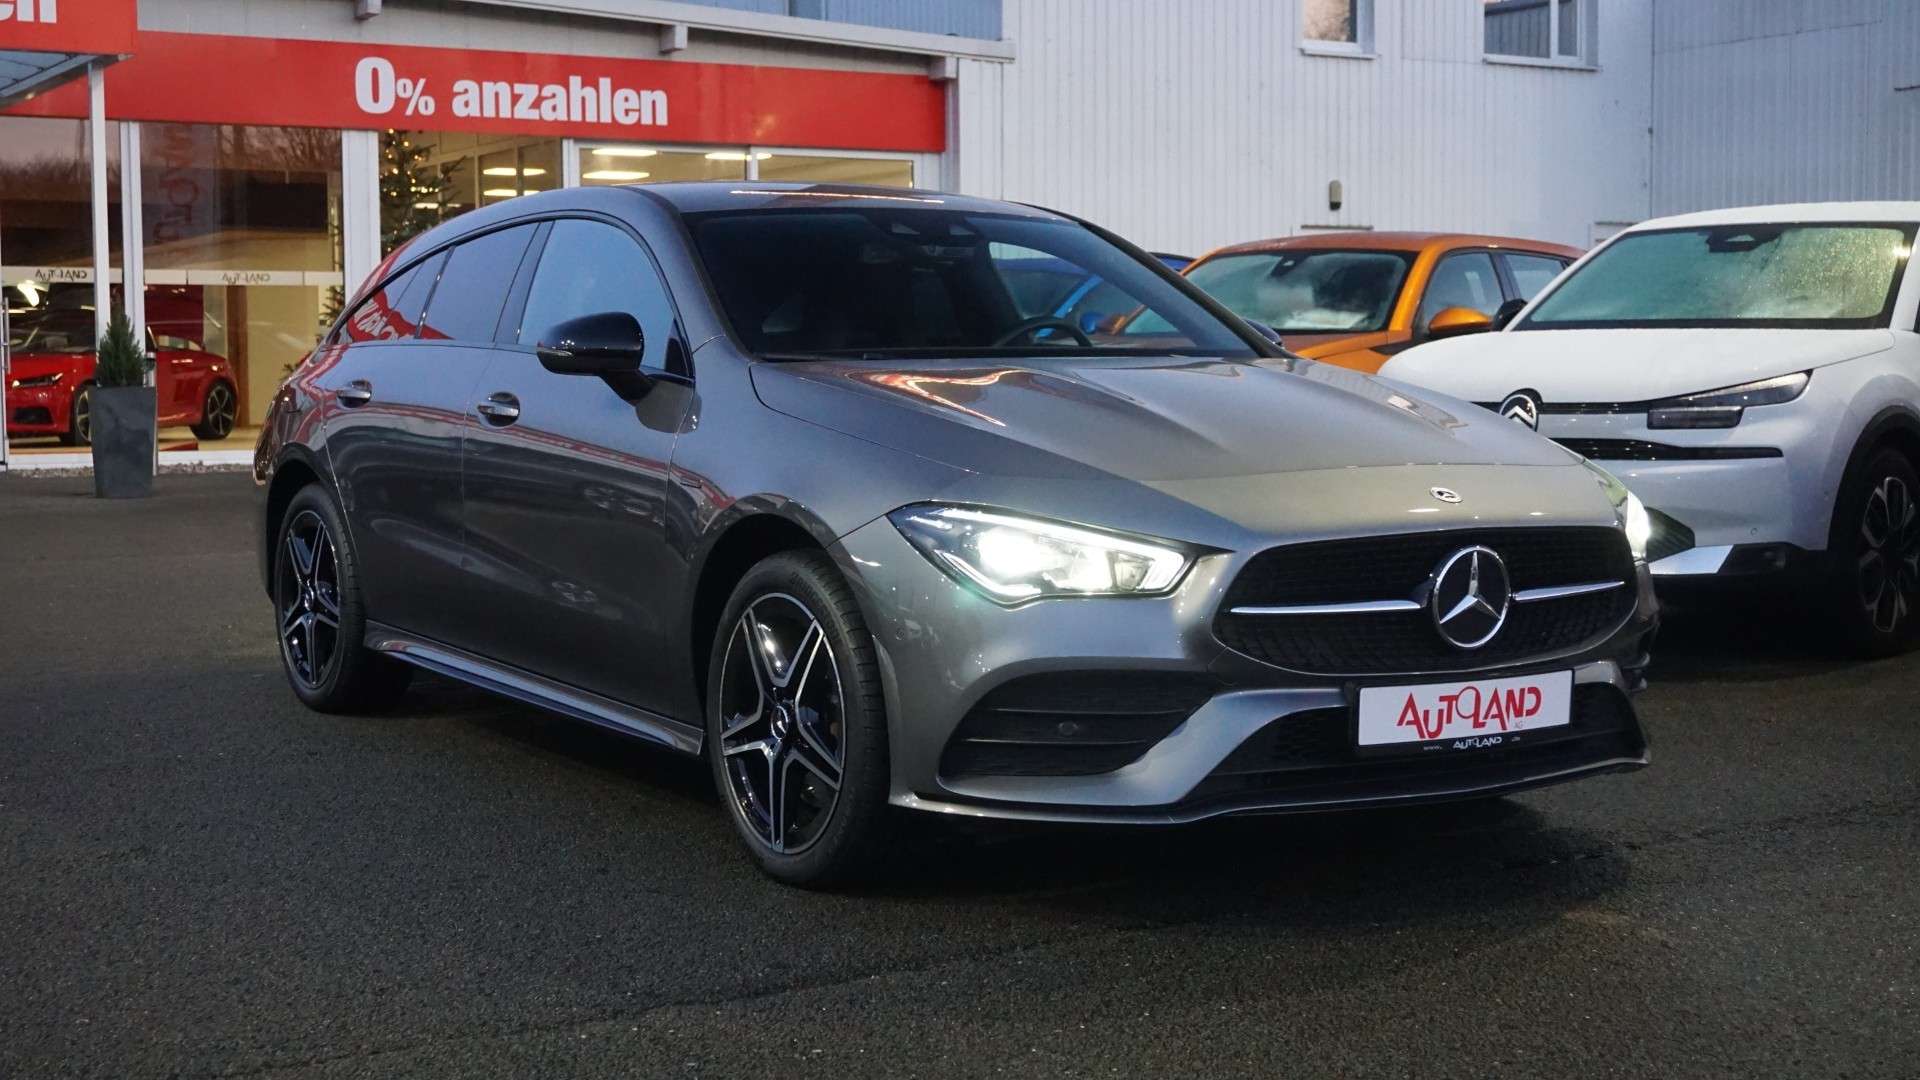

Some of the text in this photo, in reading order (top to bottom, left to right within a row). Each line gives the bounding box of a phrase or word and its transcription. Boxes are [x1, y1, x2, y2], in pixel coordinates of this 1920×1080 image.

[355, 56, 668, 126] 0% anzahlen
[1397, 686, 1542, 739] AUTOLAND
[1453, 736, 1502, 750] AUTOLAND
